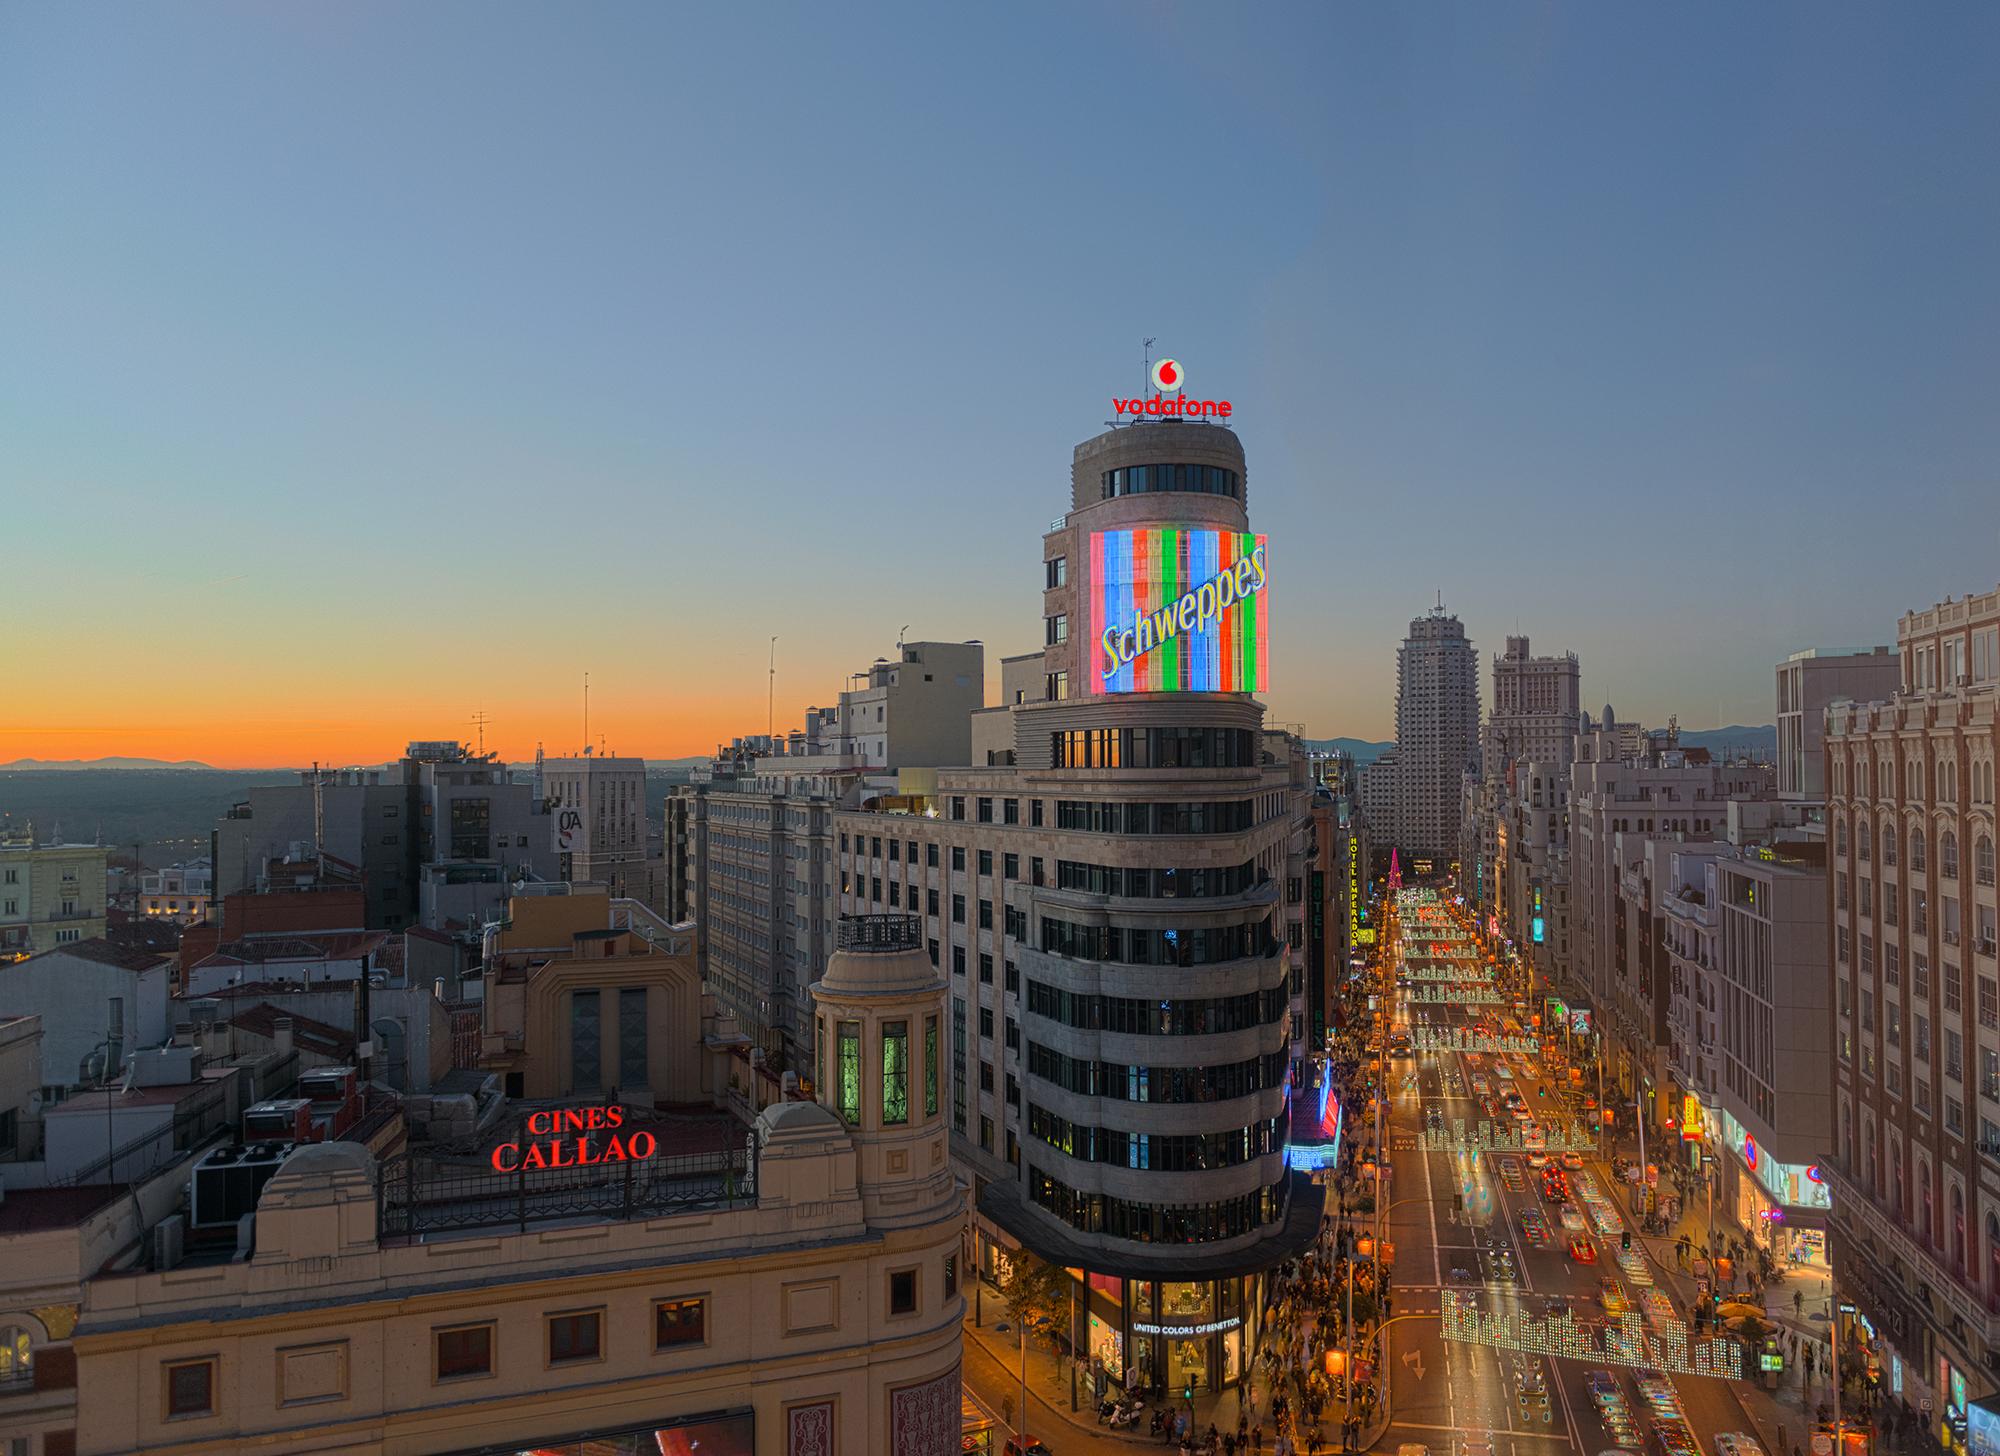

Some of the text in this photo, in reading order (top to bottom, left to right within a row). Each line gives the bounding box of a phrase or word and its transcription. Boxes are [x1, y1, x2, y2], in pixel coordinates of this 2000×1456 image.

[1112, 394, 1232, 417] vodafone
[1102, 544, 1266, 680] Schweppes
[1350, 837, 1359, 947] HOTEL EMPERADOR
[1312, 873, 1324, 1047] HOTEL REX
[528, 1106, 623, 1135] CINES
[491, 1131, 656, 1172] CALLAO
[1133, 1317, 1240, 1335] UNITED COLORS OF BENETTON
